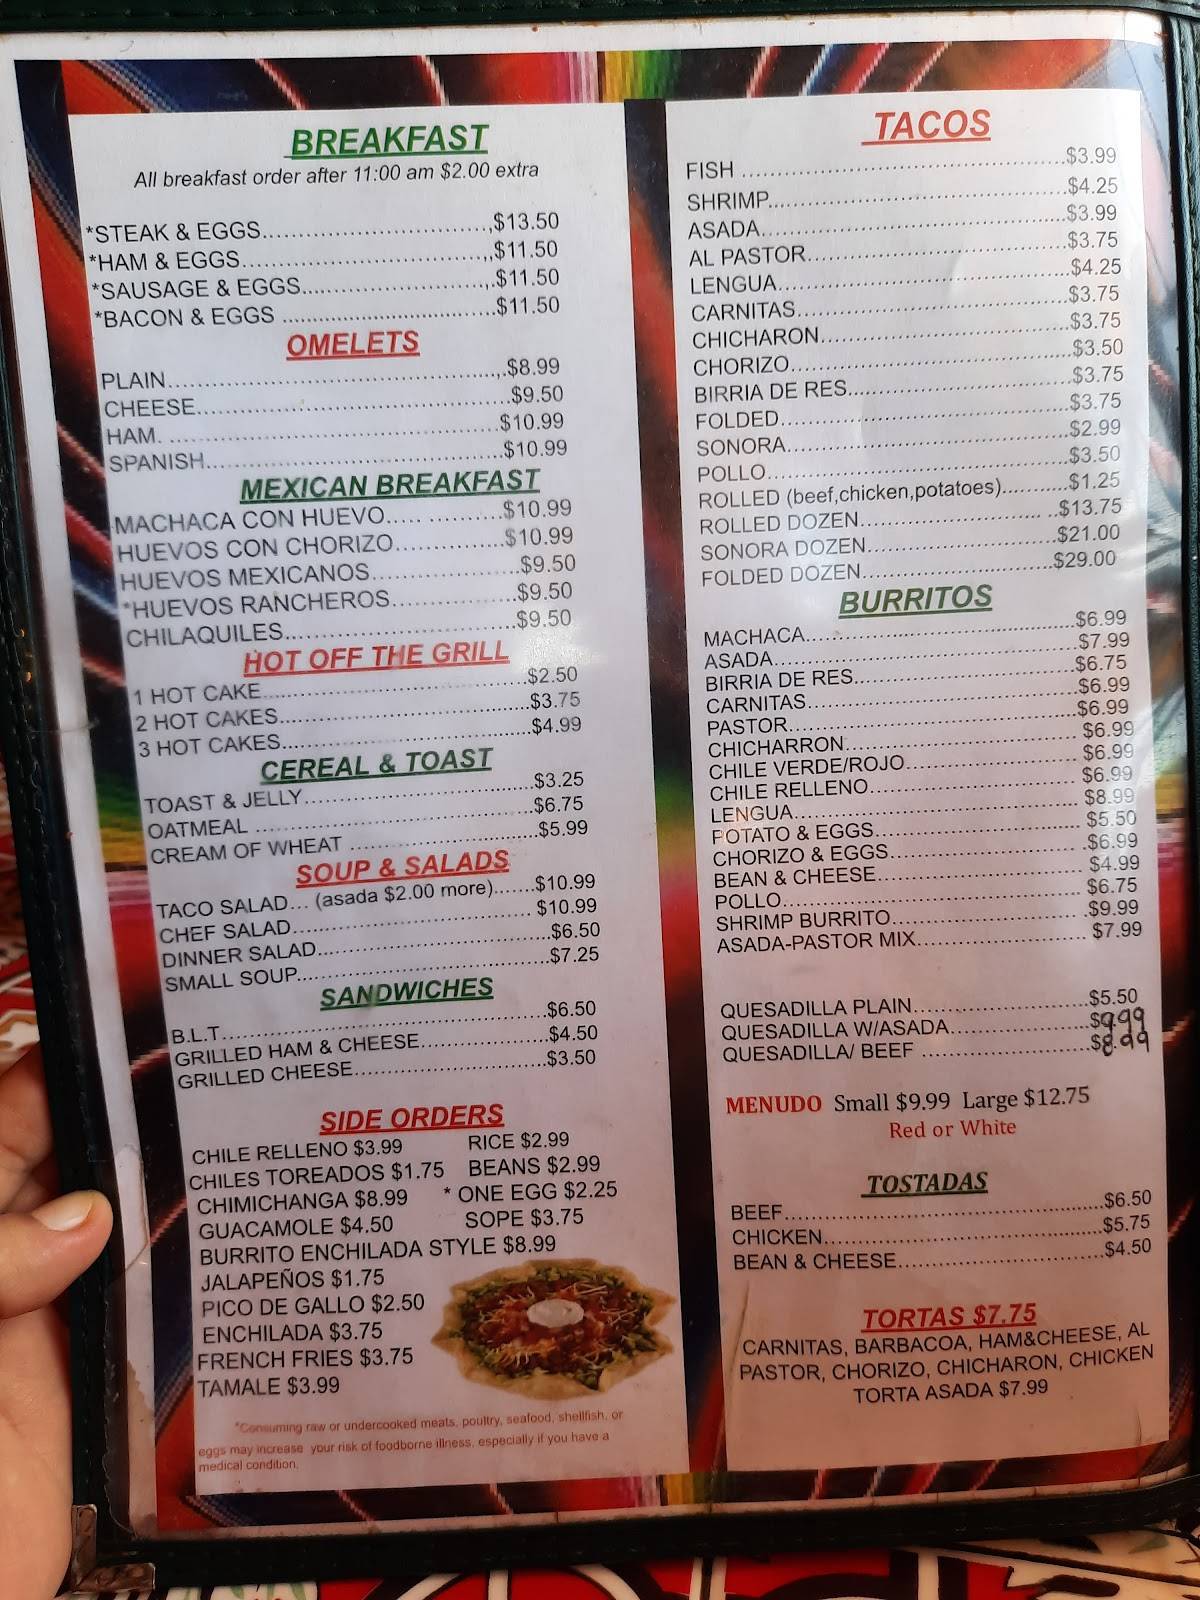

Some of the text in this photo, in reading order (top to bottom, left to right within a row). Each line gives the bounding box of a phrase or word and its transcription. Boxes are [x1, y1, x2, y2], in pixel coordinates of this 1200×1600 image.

[290, 124, 489, 157] BREAKFAST
[874, 109, 991, 144] TACOS
[134, 160, 538, 188] All breakfast order after 11:00 am $2.00 extra
[687, 146, 1116, 180] FISH $3.99
[688, 176, 1118, 212] SHRIMP $4.25
[176, 223, 190, 241] &
[197, 221, 260, 240] EGGS
[494, 211, 559, 233] $13.50
[688, 204, 1116, 240] ASADA $3.99
[190, 308, 205, 326] &
[211, 306, 274, 325] EGGS
[497, 296, 559, 317] $11.50
[692, 285, 1119, 322] CARNITAS $3.75
[287, 329, 420, 359] OMELETS
[105, 385, 563, 418] CHEESE $9.50
[240, 468, 540, 503] MEXICAN BREAKFAST
[115, 498, 571, 534] MACHACA CON HUEVO $10.99
[701, 524, 1120, 561] SONORA DOZEN $21.00
[839, 584, 993, 619] BURRITOS
[127, 609, 571, 647] CHILAQUILES $9.50
[704, 610, 1126, 647] MACHACA $6.99
[244, 640, 510, 677] HOT OFF THE GRILL
[704, 632, 1130, 670] ASADA $7.99
[707, 676, 1130, 714] CARNITAS $6.99
[139, 716, 581, 758] 3 HOT CAKES $4.99
[261, 748, 493, 784] CEREAL & TOAST
[148, 796, 583, 839] OATMEAL $6.75
[296, 849, 510, 888] SOUP & SALADS
[156, 873, 595, 919] TACO SALAD (asada $2.00 more) $10.99
[320, 977, 494, 1012] SANDWICHES
[721, 988, 1138, 1020] QUESADILLA PLAIN $5.50
[722, 1022, 848, 1041] QUESADILLA
[854, 1019, 949, 1037] W/ASADA
[178, 1049, 596, 1089] GRILLED CHEESE $3.50
[723, 1043, 854, 1063] QUESADILLA/
[862, 1042, 913, 1059] BEEF
[726, 1085, 1090, 1114] MENUDO Small $9.99 Large $12.75
[320, 1103, 505, 1136] SIDE ORDERS
[889, 1119, 1016, 1139] Red or White
[469, 1155, 600, 1177] BEANS $2.99
[867, 1171, 988, 1198] TOSTADAS
[197, 1189, 407, 1215] CHIMICHANGA $8.99
[466, 1208, 583, 1229] SOPE $3.75
[731, 1189, 1151, 1221] BEEF $6.50
[198, 1215, 393, 1240] GUACAMOLE $4.50
[733, 1214, 1150, 1245] CHICKEN $5.75
[734, 1238, 1151, 1270] BEAN & CHEESE $4.50
[201, 1268, 384, 1292] JALAPEÑOS $1.75
[863, 1302, 1037, 1332] TORTAS $7.75
[743, 1321, 1150, 1357] CARNITAS, BARBACOA, HAM&CHEESE, AL
[740, 1344, 1153, 1383] PASTOR, CHORIZO, CHICHARON, CHICKEN
[198, 1376, 339, 1398] TAMALE $3.99
[853, 1378, 1048, 1404] TORTA ASADA $7.99
[345, 1419, 416, 1431] undercooked
[612, 1411, 623, 1420] or
[199, 1448, 225, 1458] eggs
[230, 1447, 252, 1456] may
[256, 1444, 303, 1454] increase
[311, 1443, 334, 1455] your
[338, 1441, 357, 1451] risk
[361, 1440, 372, 1450] of
[375, 1438, 432, 1451] foodborne
[478, 1433, 534, 1448] especially
[537, 1431, 544, 1443] if
[548, 1433, 567, 1445] you
[571, 1431, 598, 1442] have
[603, 1432, 609, 1441] a
[199, 1460, 242, 1472] medical
